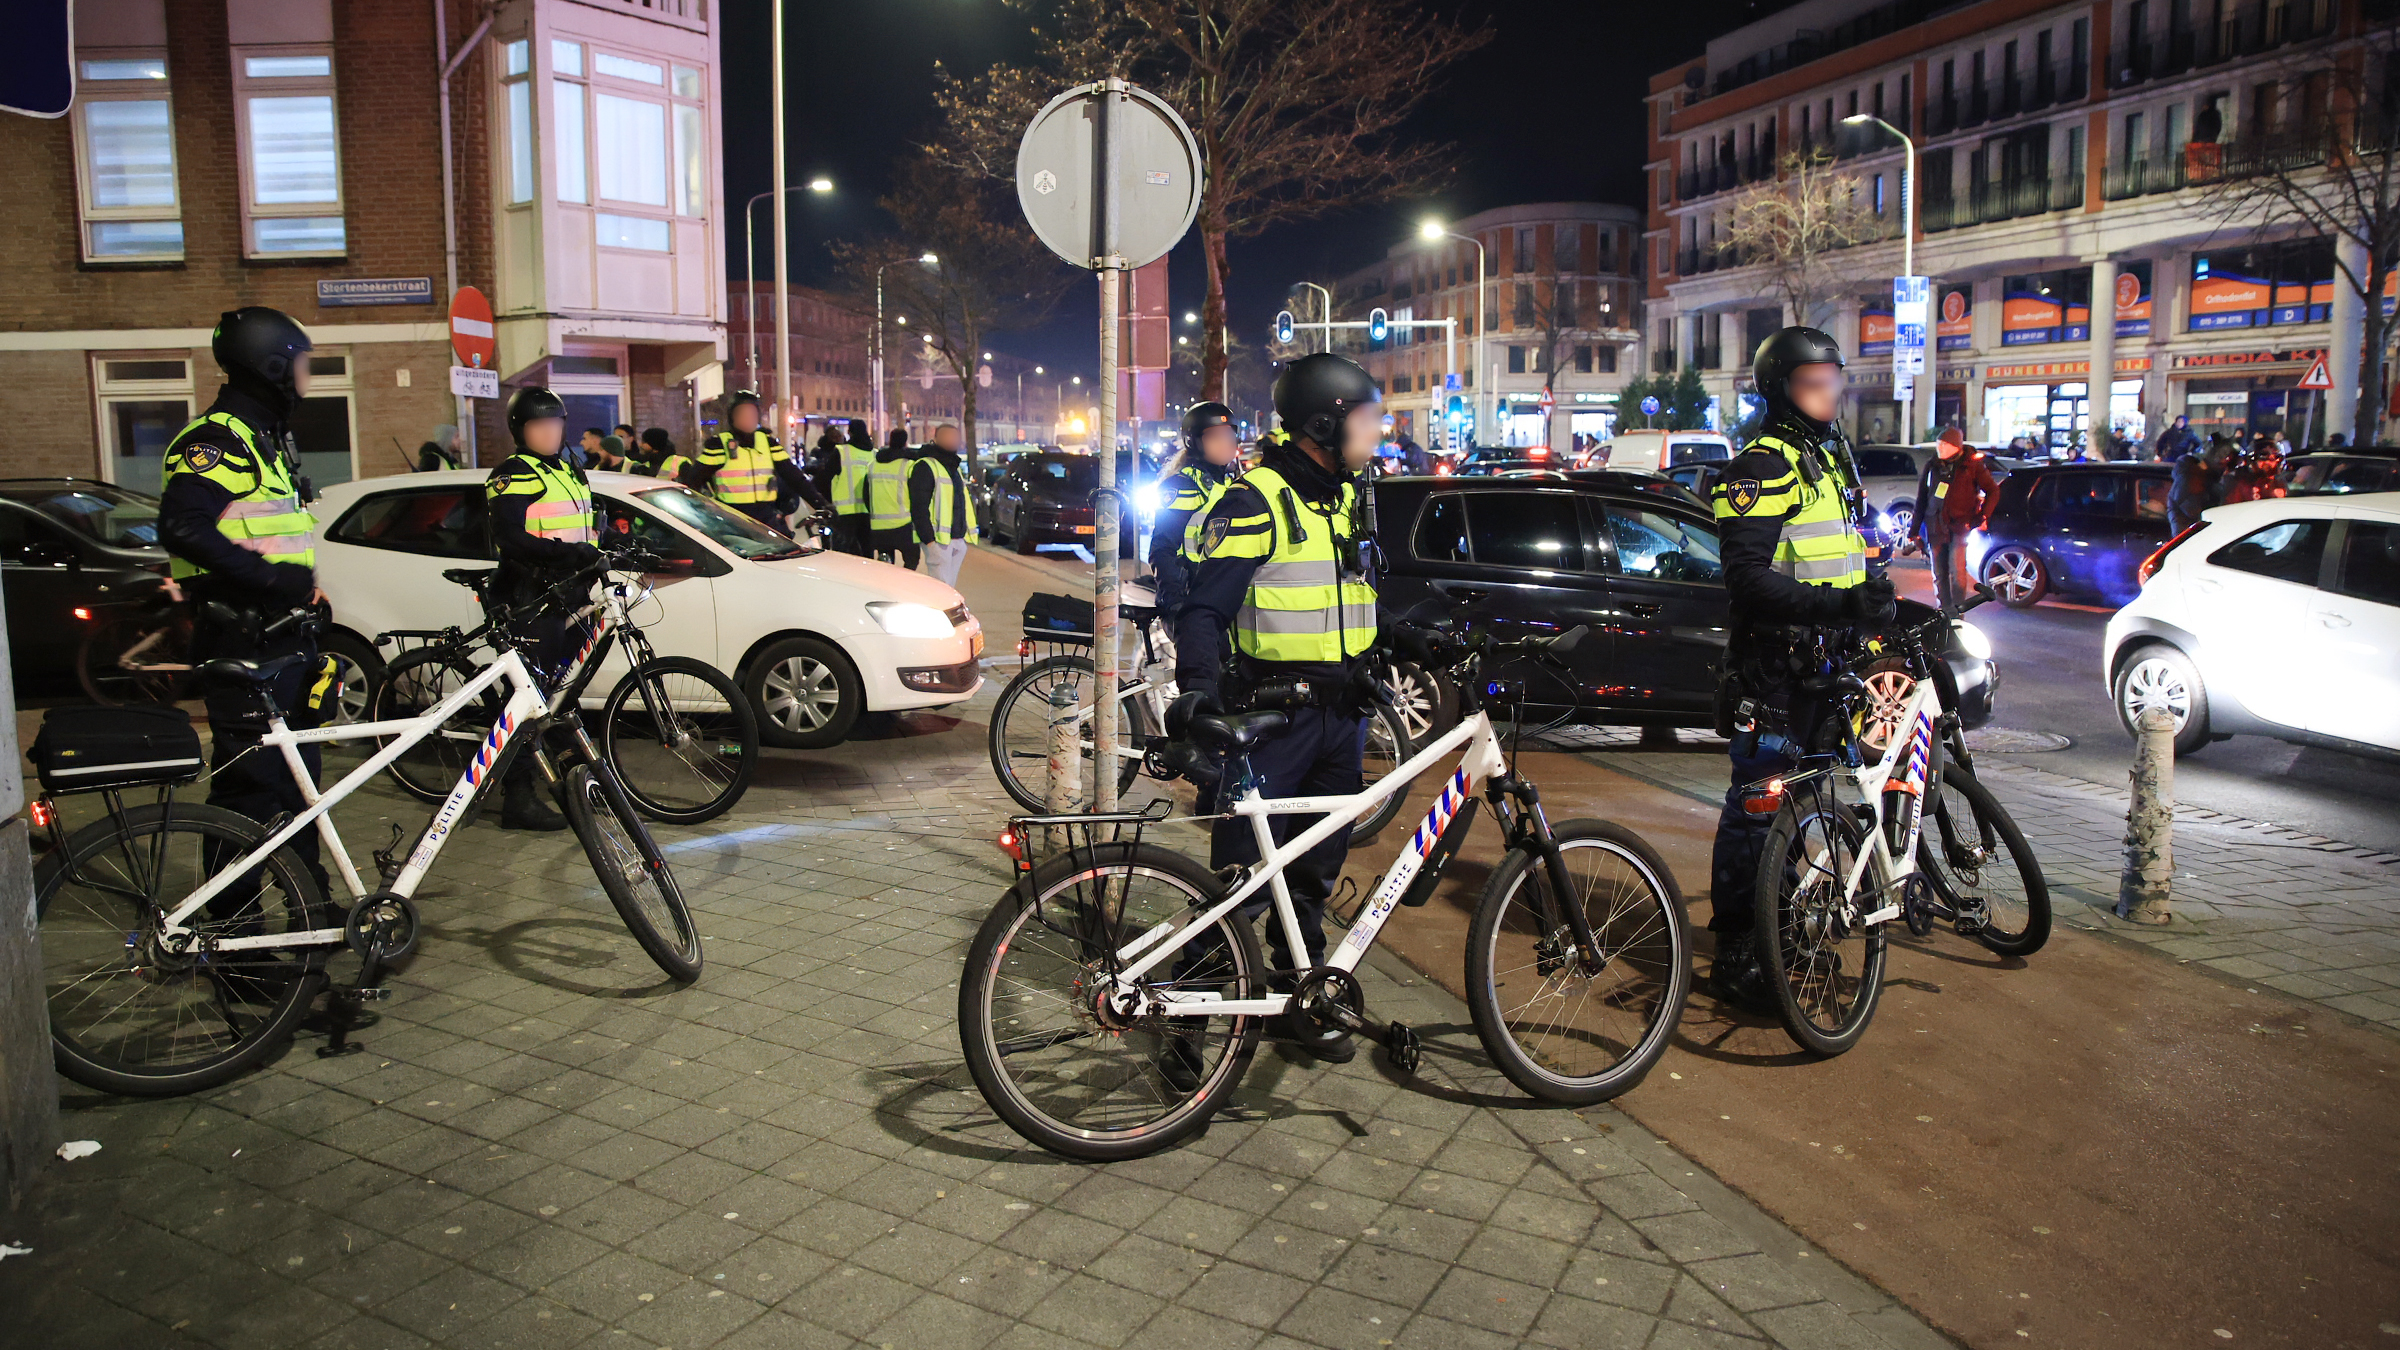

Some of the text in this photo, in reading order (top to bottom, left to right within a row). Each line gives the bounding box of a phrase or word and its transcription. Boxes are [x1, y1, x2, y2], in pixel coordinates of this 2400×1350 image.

[322, 281, 426, 294] Stortenbekerstraat
[2052, 358, 2143, 375] BAKRIJ
[2188, 351, 2276, 366] MEDIA
[296, 729, 338, 738] SANTOS
[429, 792, 464, 841] POLITIE
[1371, 863, 1412, 919] POLITIE
